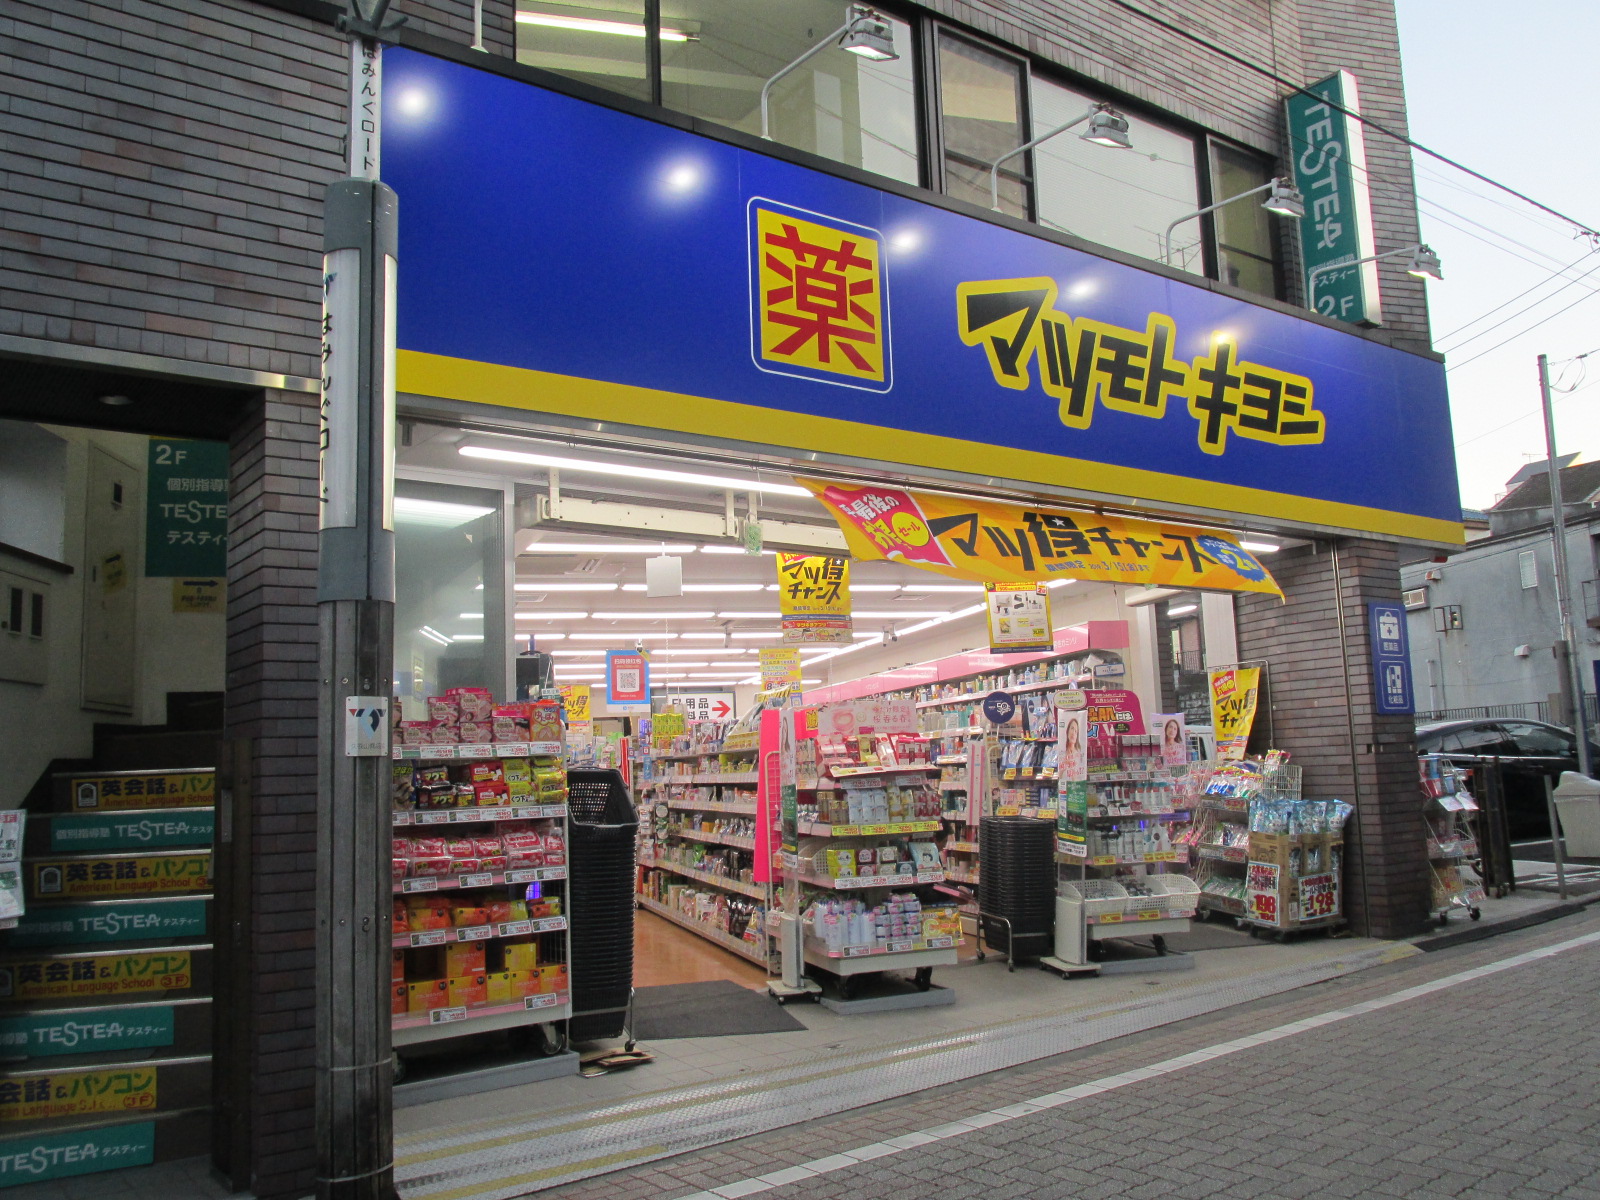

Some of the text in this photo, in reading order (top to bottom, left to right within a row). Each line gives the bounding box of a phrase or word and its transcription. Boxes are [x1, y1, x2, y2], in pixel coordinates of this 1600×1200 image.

[1300, 90, 1342, 250] TESTEA
[764, 224, 877, 371] 薬
[1318, 295, 1354, 319] 2F
[960, 279, 1322, 451] マツモトキヨシ
[155, 444, 187, 465] 2F
[167, 478, 228, 492] 個別指導
[925, 512, 1219, 573] マツ得チャンス
[781, 557, 846, 585] マツ得
[787, 581, 842, 605] チャンス
[115, 820, 190, 841] TESTEA
[69, 883, 112, 894] American
[114, 880, 158, 894] Language
[160, 878, 190, 888] School
[1254, 893, 1276, 914] 198
[78, 913, 161, 935] TESTEA
[70, 980, 119, 993] Language
[121, 977, 155, 989] School
[33, 1022, 125, 1047] TESTEA
[127, 1026, 167, 1036] テスティー
[0, 1143, 147, 1174] TESTEA テスティー
